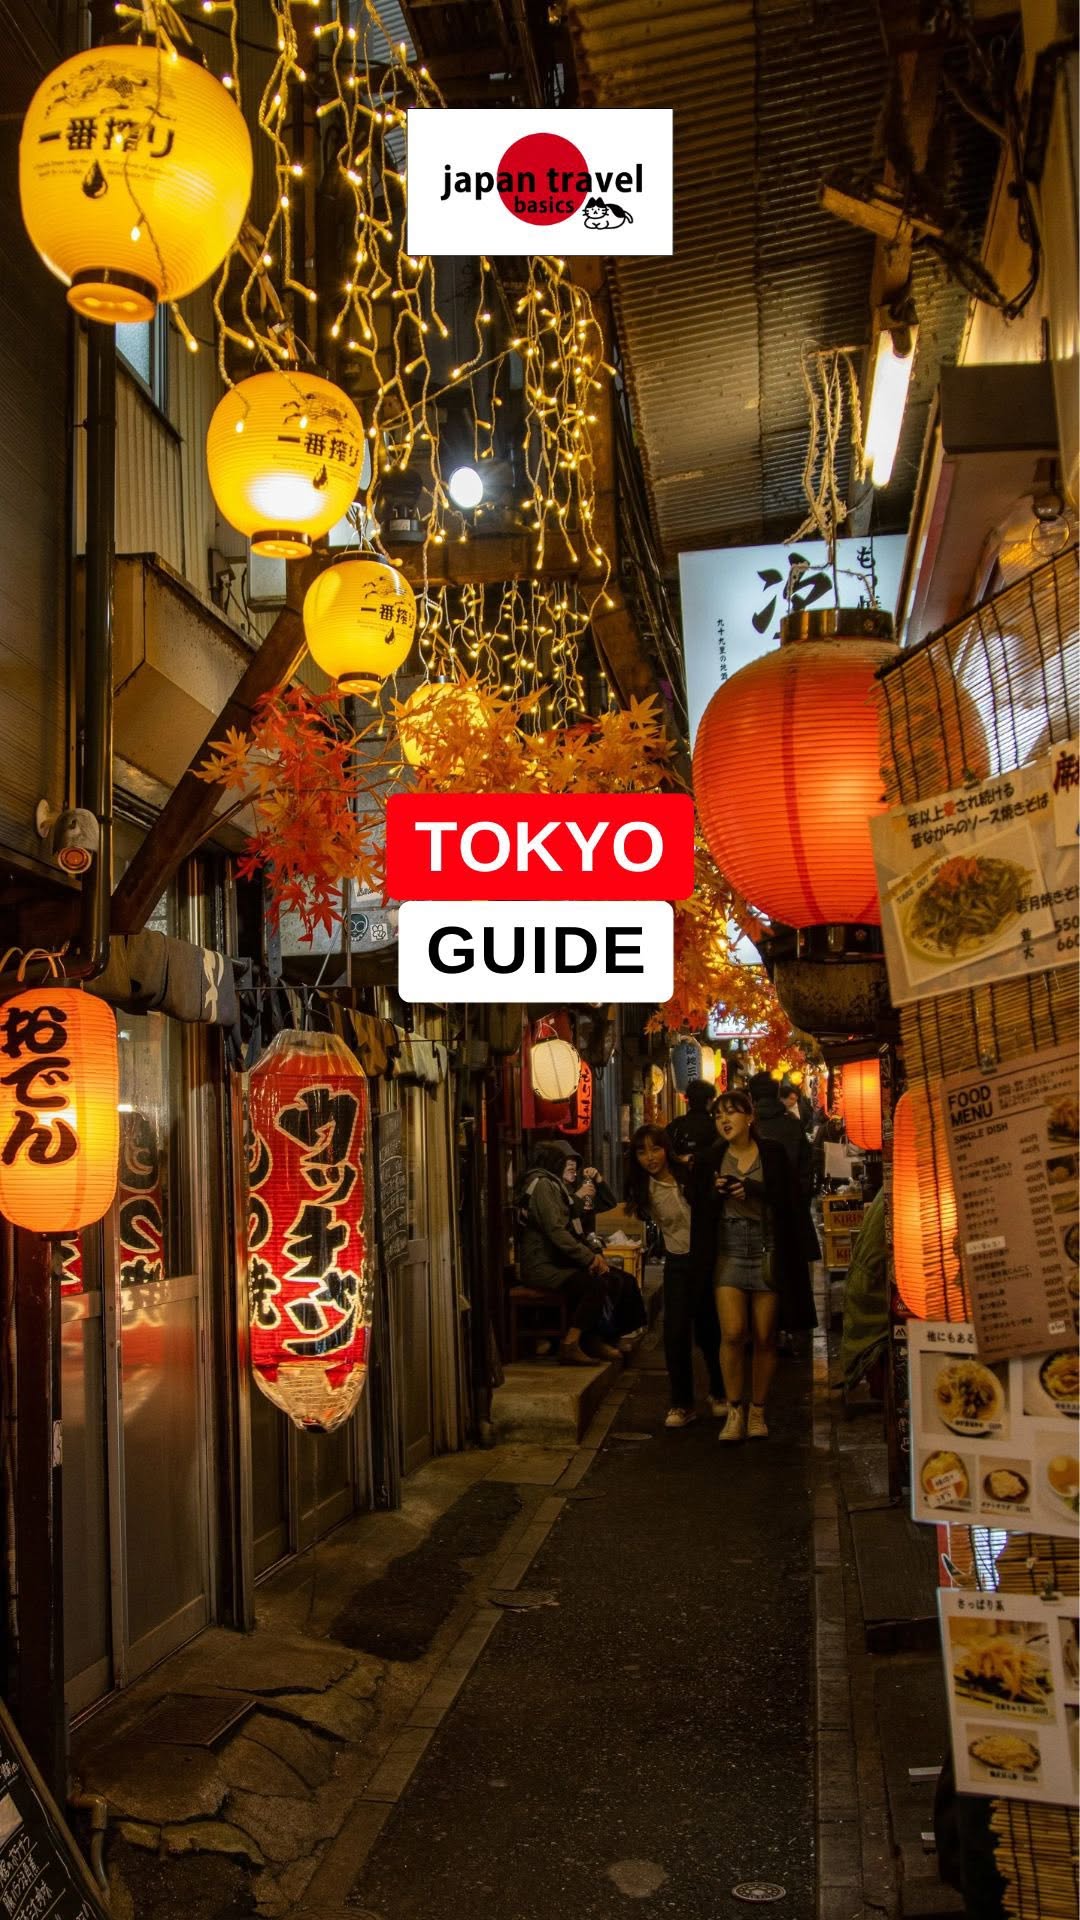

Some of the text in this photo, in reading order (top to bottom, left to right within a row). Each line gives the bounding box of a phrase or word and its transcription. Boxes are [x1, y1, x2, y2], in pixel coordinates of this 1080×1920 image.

[38, 116, 175, 159] 一番搾り
[277, 431, 360, 468] 一番搾り
[360, 603, 415, 629] 一番搾り
[910, 792, 1050, 849] 昔ながらのソース焼きそば
[0, 1005, 80, 1166] おでん
[948, 1085, 991, 1111] FOOD
[950, 1102, 993, 1128] MENU
[953, 1122, 1009, 1145] SINGLE DISH
